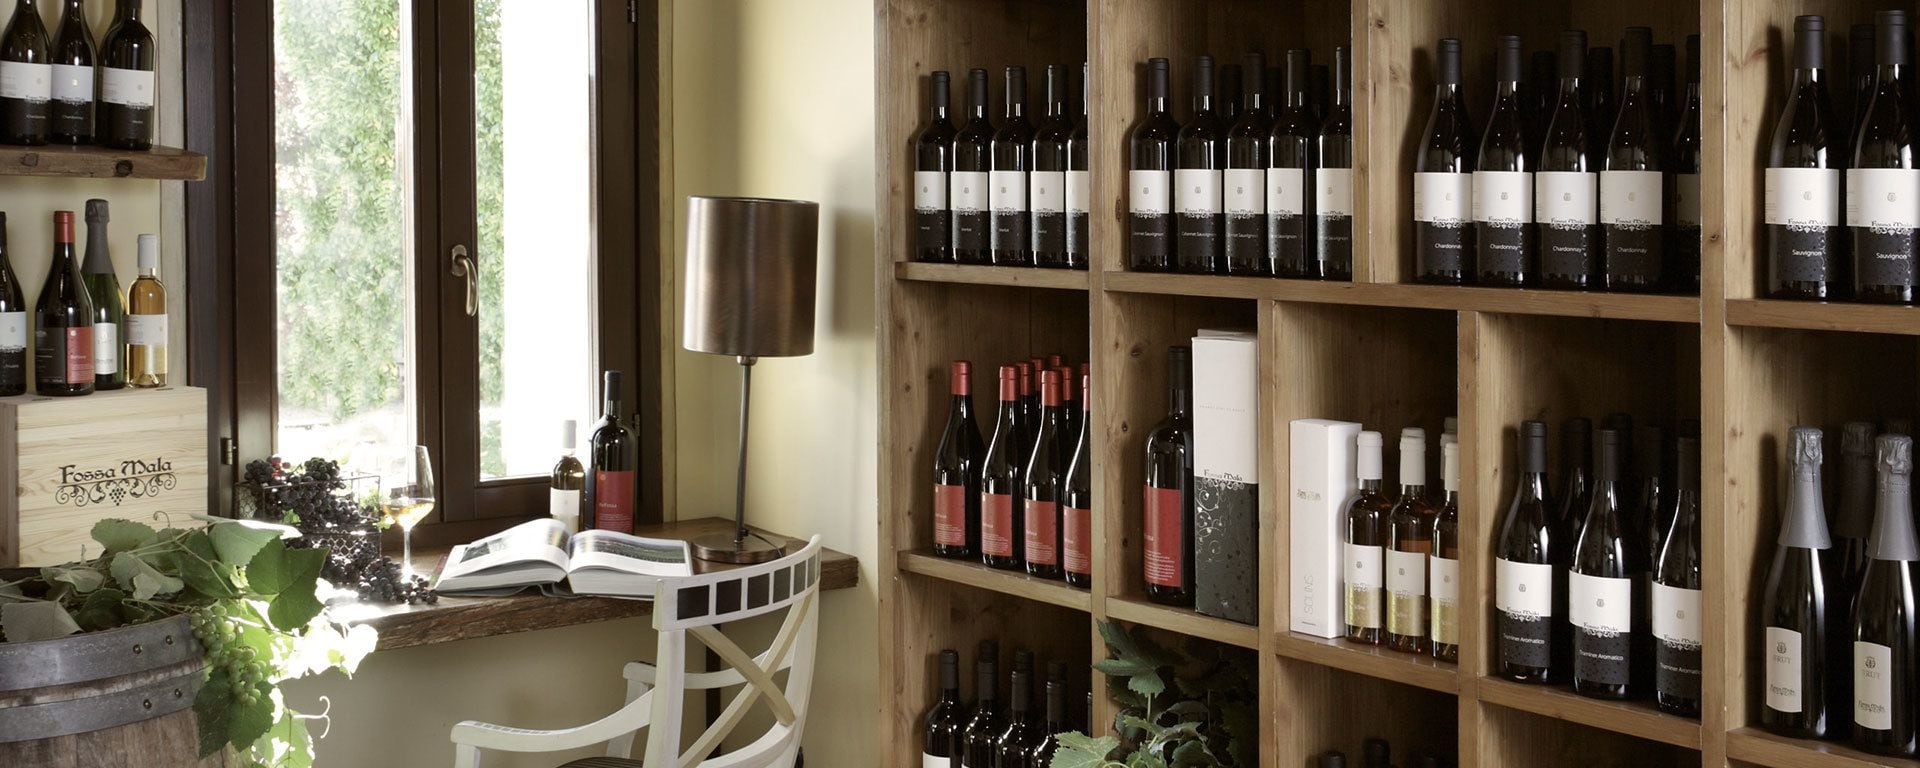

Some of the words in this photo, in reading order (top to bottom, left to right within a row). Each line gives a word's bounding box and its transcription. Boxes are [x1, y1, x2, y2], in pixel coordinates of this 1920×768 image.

[1490, 243, 1519, 251] Chardonnay
[1553, 245, 1582, 253] Chardonnay
[1792, 249, 1822, 257] Sauvignon
[1876, 252, 1908, 260] Sauvignon
[59, 464, 116, 484] Fossa
[121, 456, 172, 476] Mala
[1520, 637, 1545, 645] Aromatico
[1598, 653, 1624, 661] Aromatico
